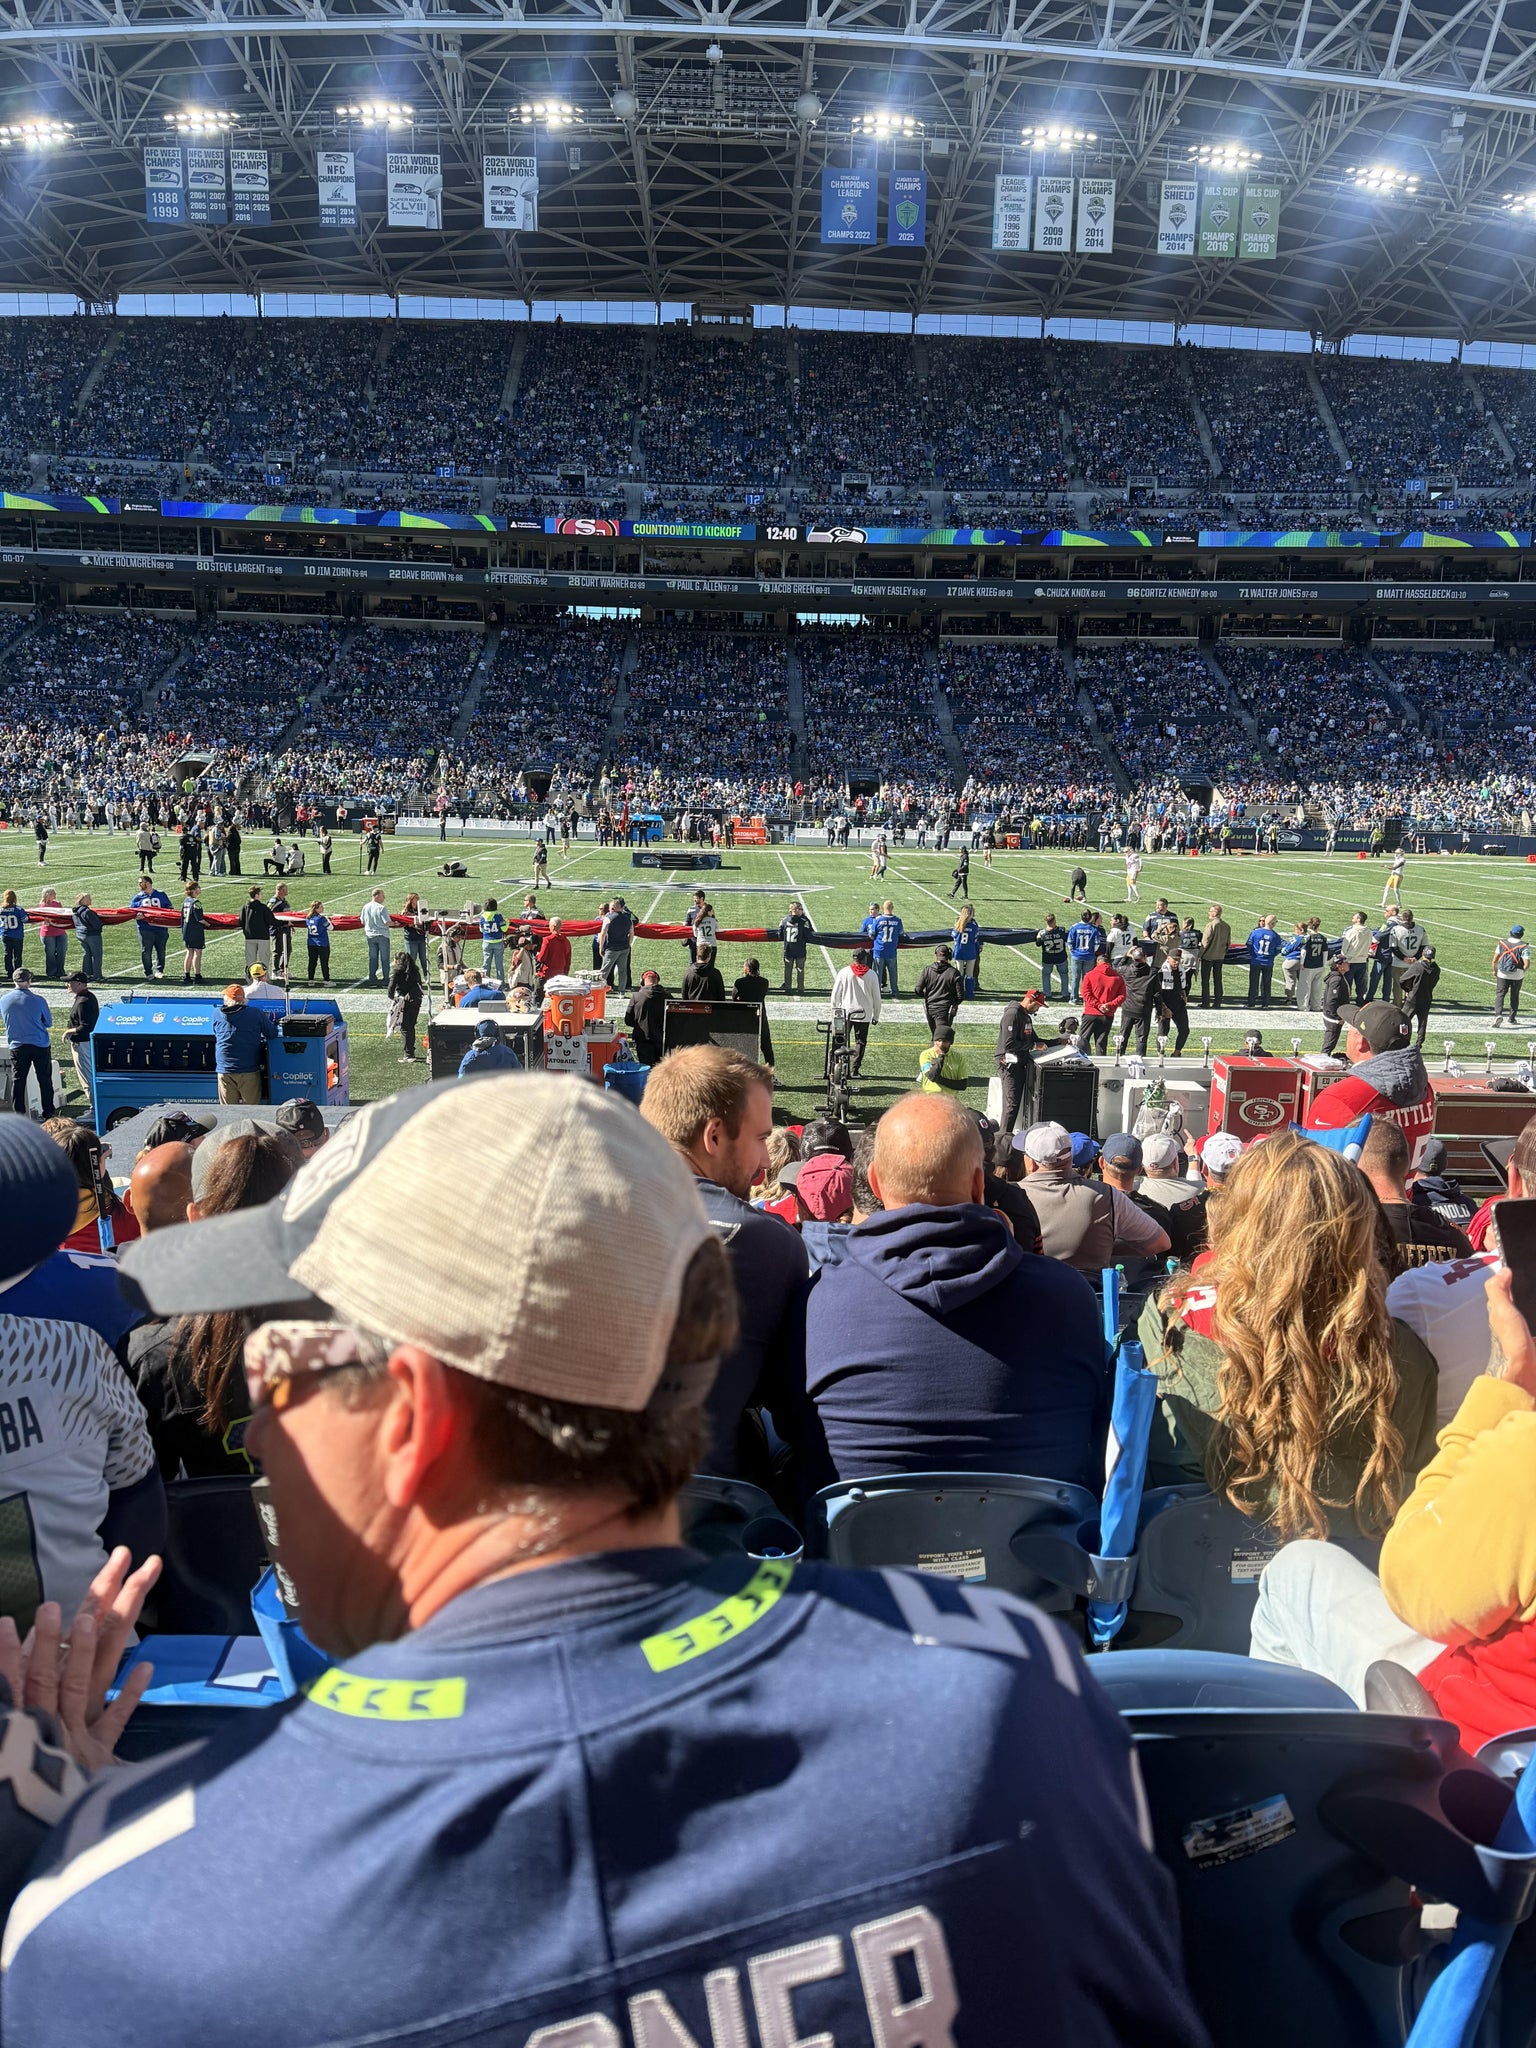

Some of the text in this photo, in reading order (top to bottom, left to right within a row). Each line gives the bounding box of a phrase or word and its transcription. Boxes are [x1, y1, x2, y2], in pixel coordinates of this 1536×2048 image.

[146, 158, 180, 167] CHAMPS
[189, 159, 224, 168] CHAMPS
[232, 160, 267, 170] CHAMPS
[389, 156, 438, 166] 2013 WORLD
[485, 158, 534, 168] 2025 WORLD
[327, 166, 345, 174] NFC
[389, 165, 438, 175] CHAMPIONS
[485, 168, 535, 177] CHAMPIONS
[830, 181, 869, 189] CHAMPIONS
[895, 182, 921, 191] CHAMPS
[1041, 185, 1071, 193] CHAMPS
[838, 189, 862, 197] LEAGUE
[1082, 186, 1112, 195] CHAMPS
[1164, 191, 1194, 200] SHIELD
[1205, 187, 1238, 196] MLS CUP
[1246, 188, 1279, 198] MLS CUP
[152, 193, 178, 203] 1988
[390, 202, 426, 211] XLVIII
[491, 206, 515, 214] LX
[153, 207, 178, 217] 1999
[1043, 227, 1063, 236] 2009
[1086, 229, 1104, 237] 2011
[1202, 232, 1234, 241] CHAMPS
[1043, 237, 1062, 245] 2010
[1160, 233, 1193, 241] CHAMPS
[1244, 233, 1275, 243] CHAMPS
[1085, 238, 1104, 247] 2014
[1166, 242, 1185, 251] 2014
[1207, 241, 1228, 251] 2016
[1248, 243, 1269, 253] 2019
[271, 476, 280, 485] 12
[633, 524, 742, 538] COUNTDOWN TO KICKOFF
[767, 528, 797, 540] 12:40
[94, 557, 156, 569] MIKE HOLMGREN
[197, 562, 265, 573] 80 STEVE LARGENT
[304, 566, 350, 576] 10 JIM ZORN
[389, 570, 446, 581] 22 DAVE BROWN
[491, 574, 532, 584] PETE GROSS
[569, 577, 629, 588] 28 CURT WARNER
[677, 581, 693, 590] PAUL
[703, 582, 722, 592] ALLEN
[759, 584, 814, 594] 79 JACOB GREEN
[851, 586, 912, 596] 45 KENNY EASLEY
[947, 587, 998, 597] 17 DAVE KRIEG
[1047, 588, 1090, 597] CHUCK KNOX
[1127, 588, 1200, 598] 96 CORTEZ KENNEDY
[1239, 588, 1301, 598] 71 WALTER JONES
[1377, 589, 1451, 598] 8 MATT HASSELBECK
[484, 923, 499, 933] 54
[701, 926, 712, 937] 12
[785, 927, 799, 942] 12
[882, 927, 894, 943] 11
[961, 933, 968, 944] 8
[1122, 934, 1132, 945] 12
[1044, 939, 1064, 953] 23
[1078, 935, 1089, 950] 11
[1258, 940, 1270, 955] 11
[1404, 936, 1418, 950] 12
[559, 999, 574, 1015] G
[282, 1072, 313, 1081] Copilot
[1254, 1104, 1274, 1120] SF
